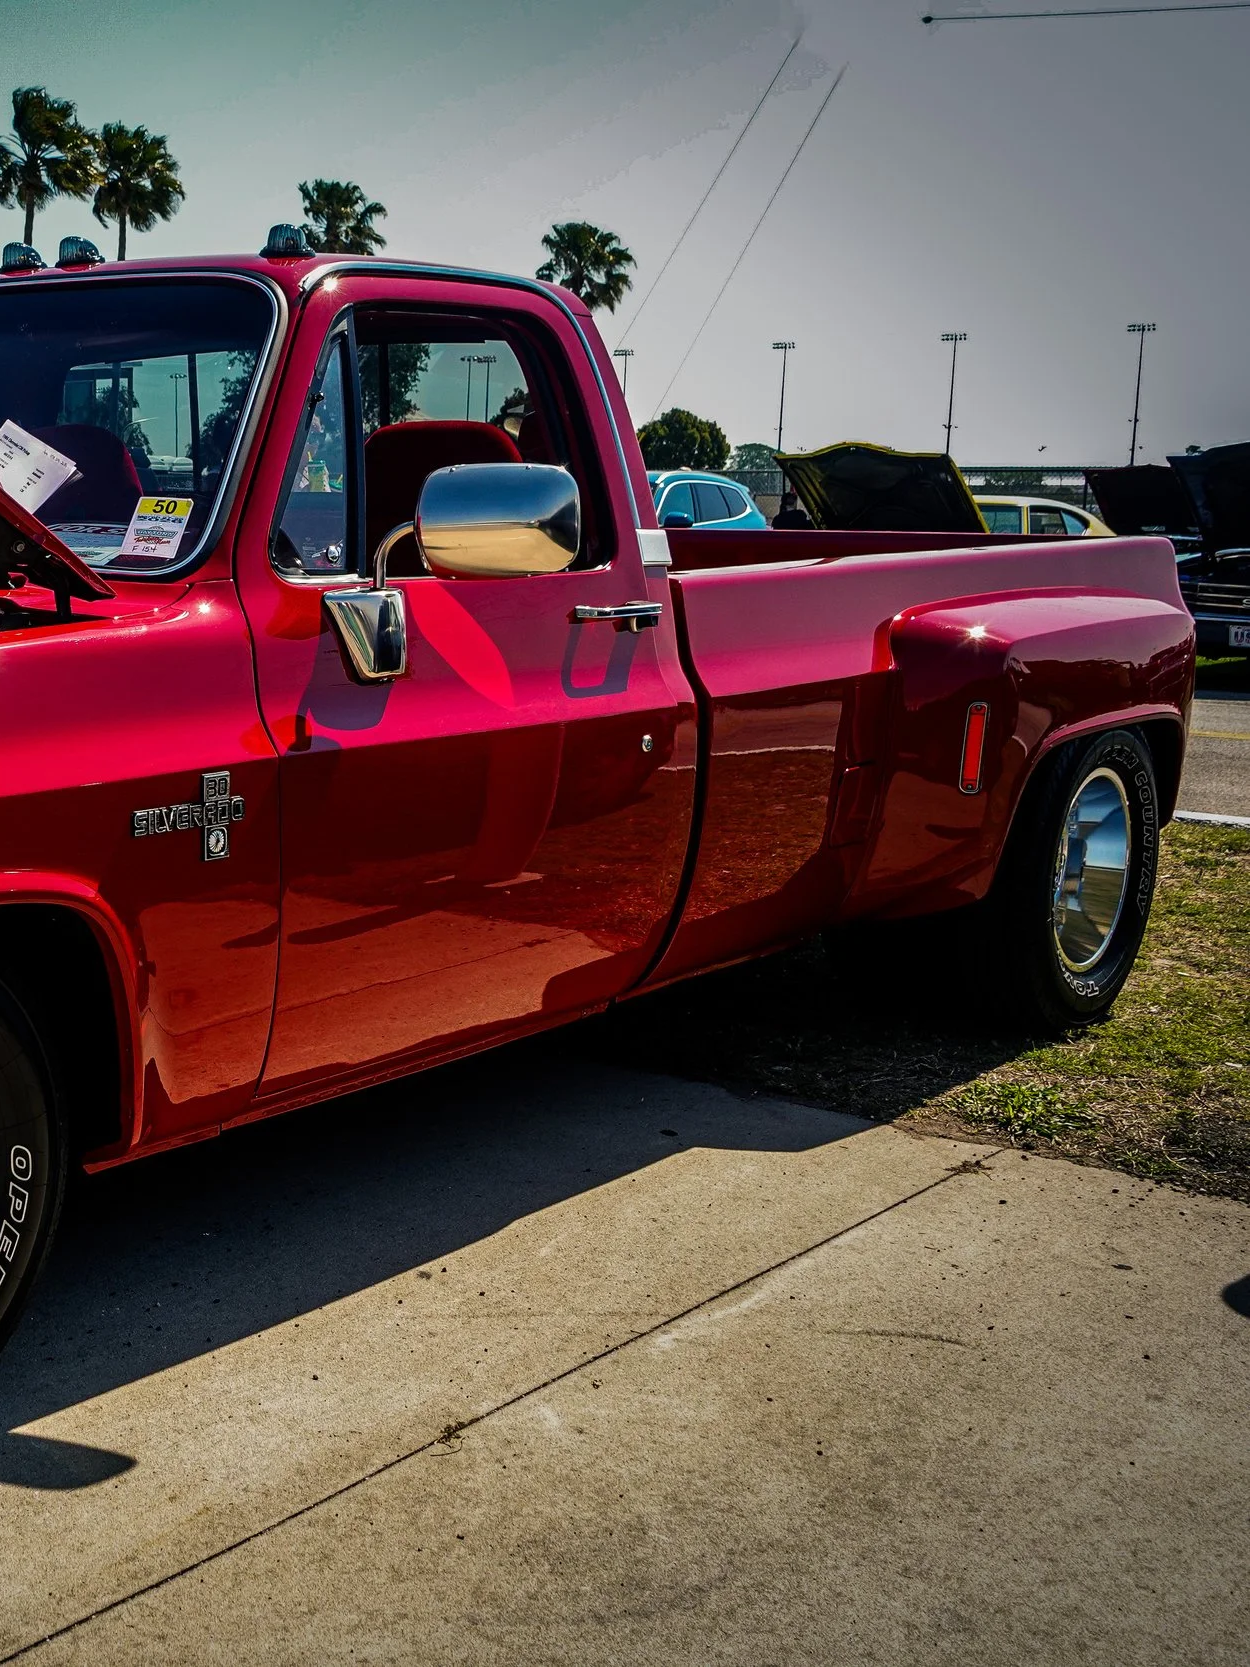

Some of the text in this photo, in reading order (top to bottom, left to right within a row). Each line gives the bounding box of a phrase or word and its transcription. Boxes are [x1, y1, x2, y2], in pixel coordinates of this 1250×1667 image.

[152, 500, 177, 514] 50
[207, 778, 228, 799] 30
[133, 796, 244, 837] SILVERADO
[1135, 770, 1155, 915] COUNTRY
